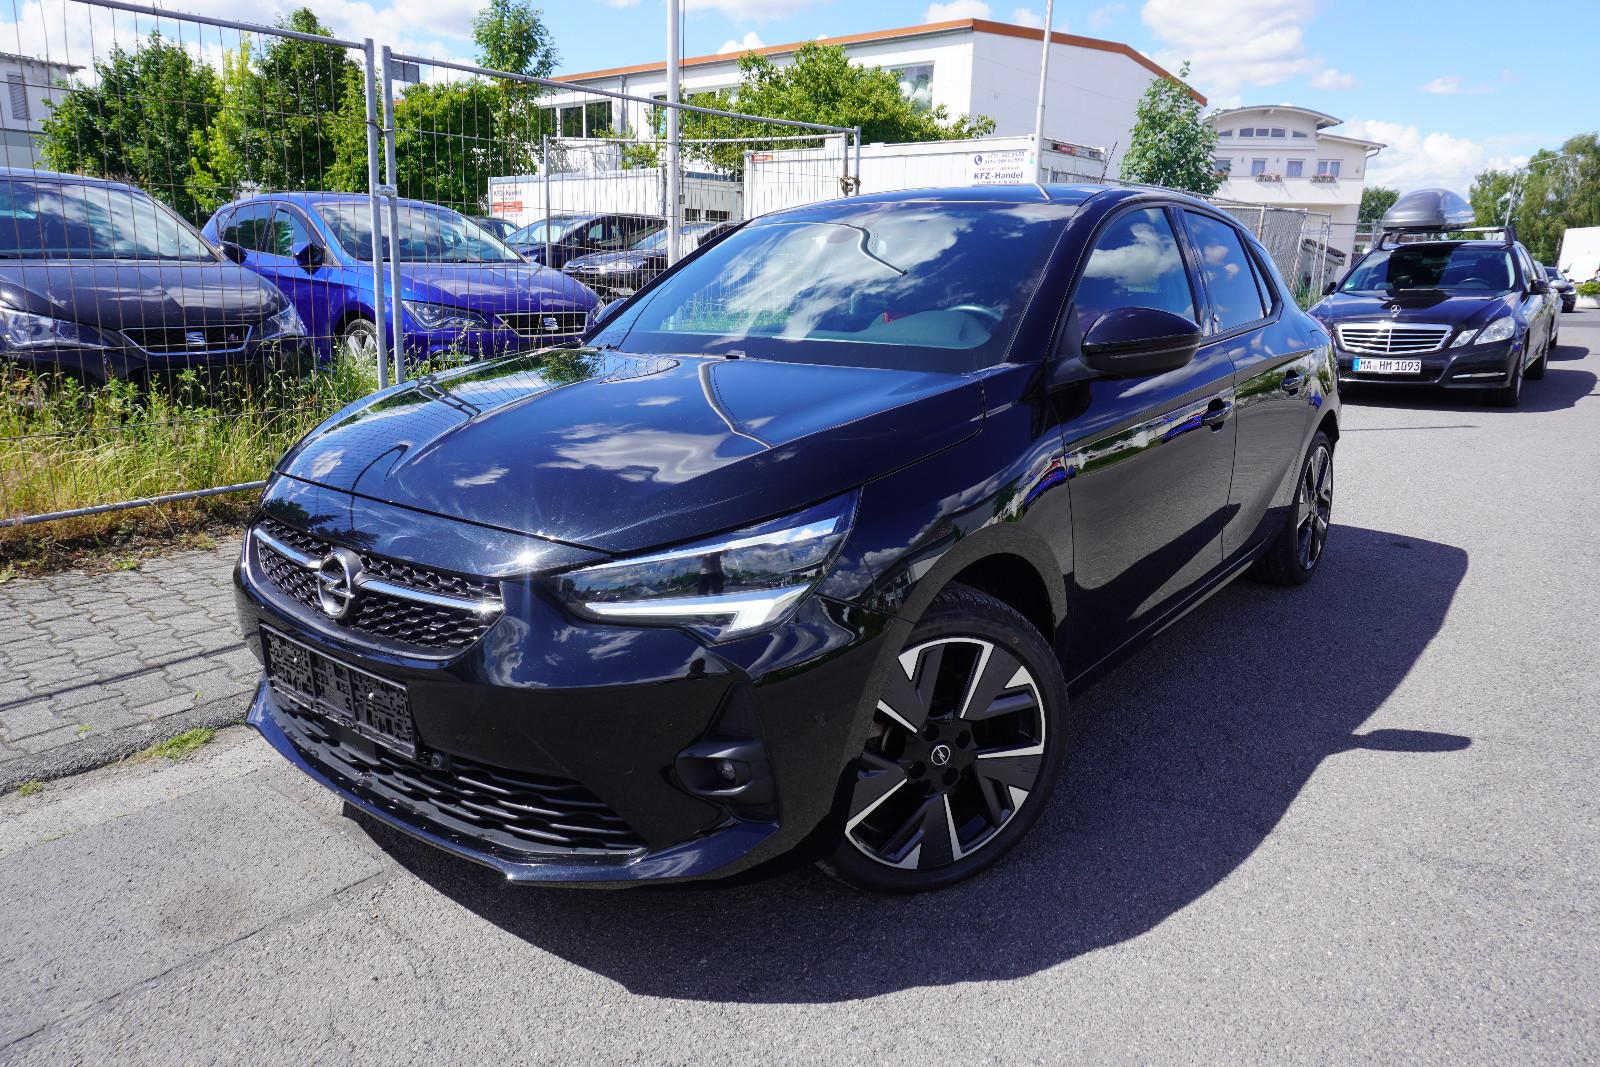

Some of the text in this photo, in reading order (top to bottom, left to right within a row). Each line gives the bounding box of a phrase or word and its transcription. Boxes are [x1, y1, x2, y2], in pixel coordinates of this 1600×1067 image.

[1360, 360, 1421, 371] MA HM 1093
